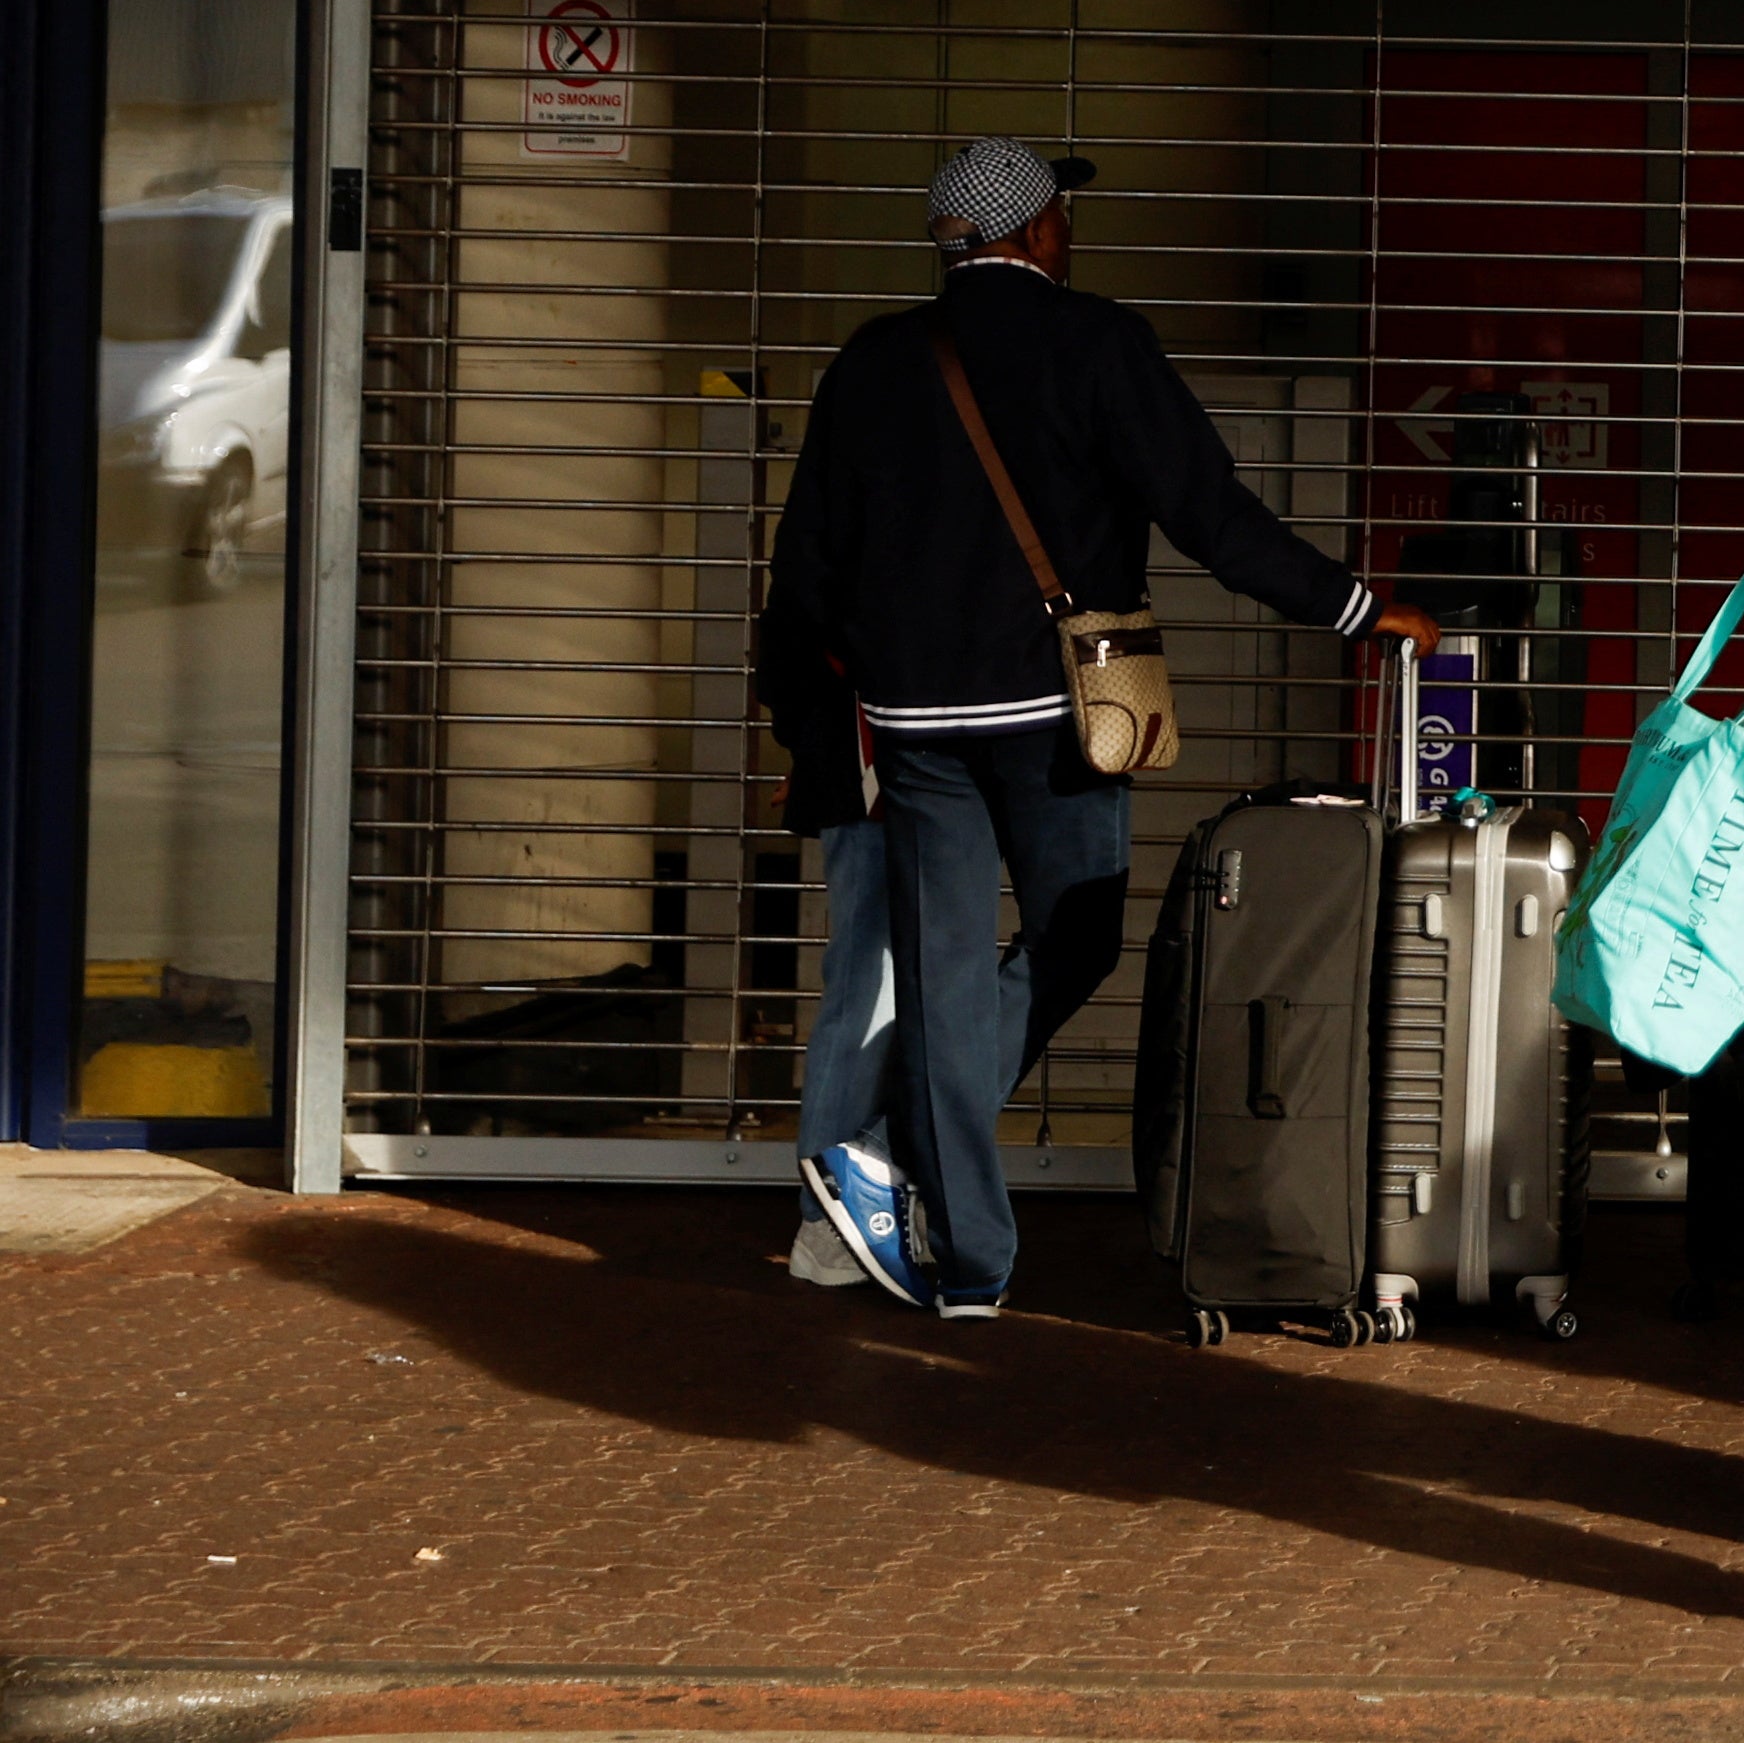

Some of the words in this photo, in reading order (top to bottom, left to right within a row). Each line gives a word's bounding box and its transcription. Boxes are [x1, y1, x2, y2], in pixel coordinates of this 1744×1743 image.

[532, 92, 553, 104] NO
[557, 93, 621, 107] SMOKING
[1391, 493, 1440, 519] Lift
[1542, 497, 1606, 523] tairs
[1651, 929, 1704, 1010] TEA
